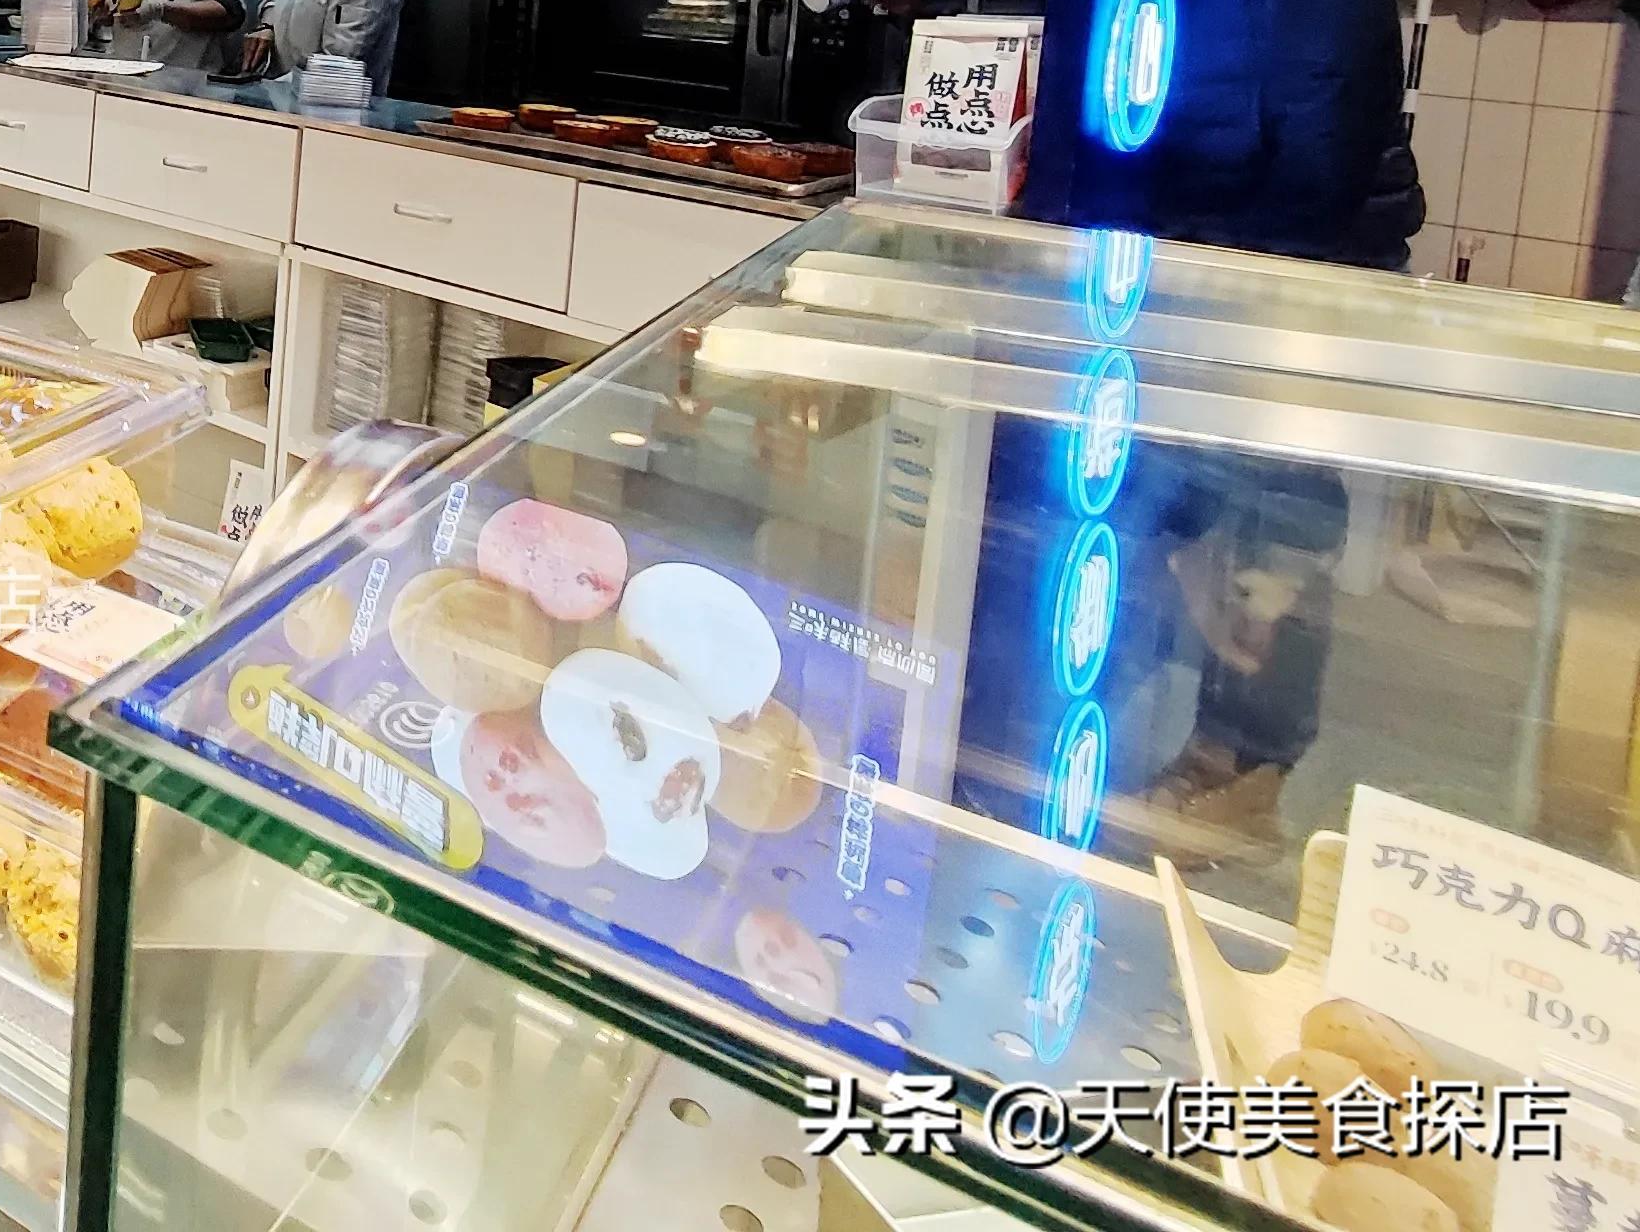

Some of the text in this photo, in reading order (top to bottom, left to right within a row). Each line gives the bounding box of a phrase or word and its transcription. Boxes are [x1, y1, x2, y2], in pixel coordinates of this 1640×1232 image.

[957, 64, 998, 135] 用点心
[1382, 940, 1449, 985] 24.8
[1520, 989, 1611, 1046] 19.9
